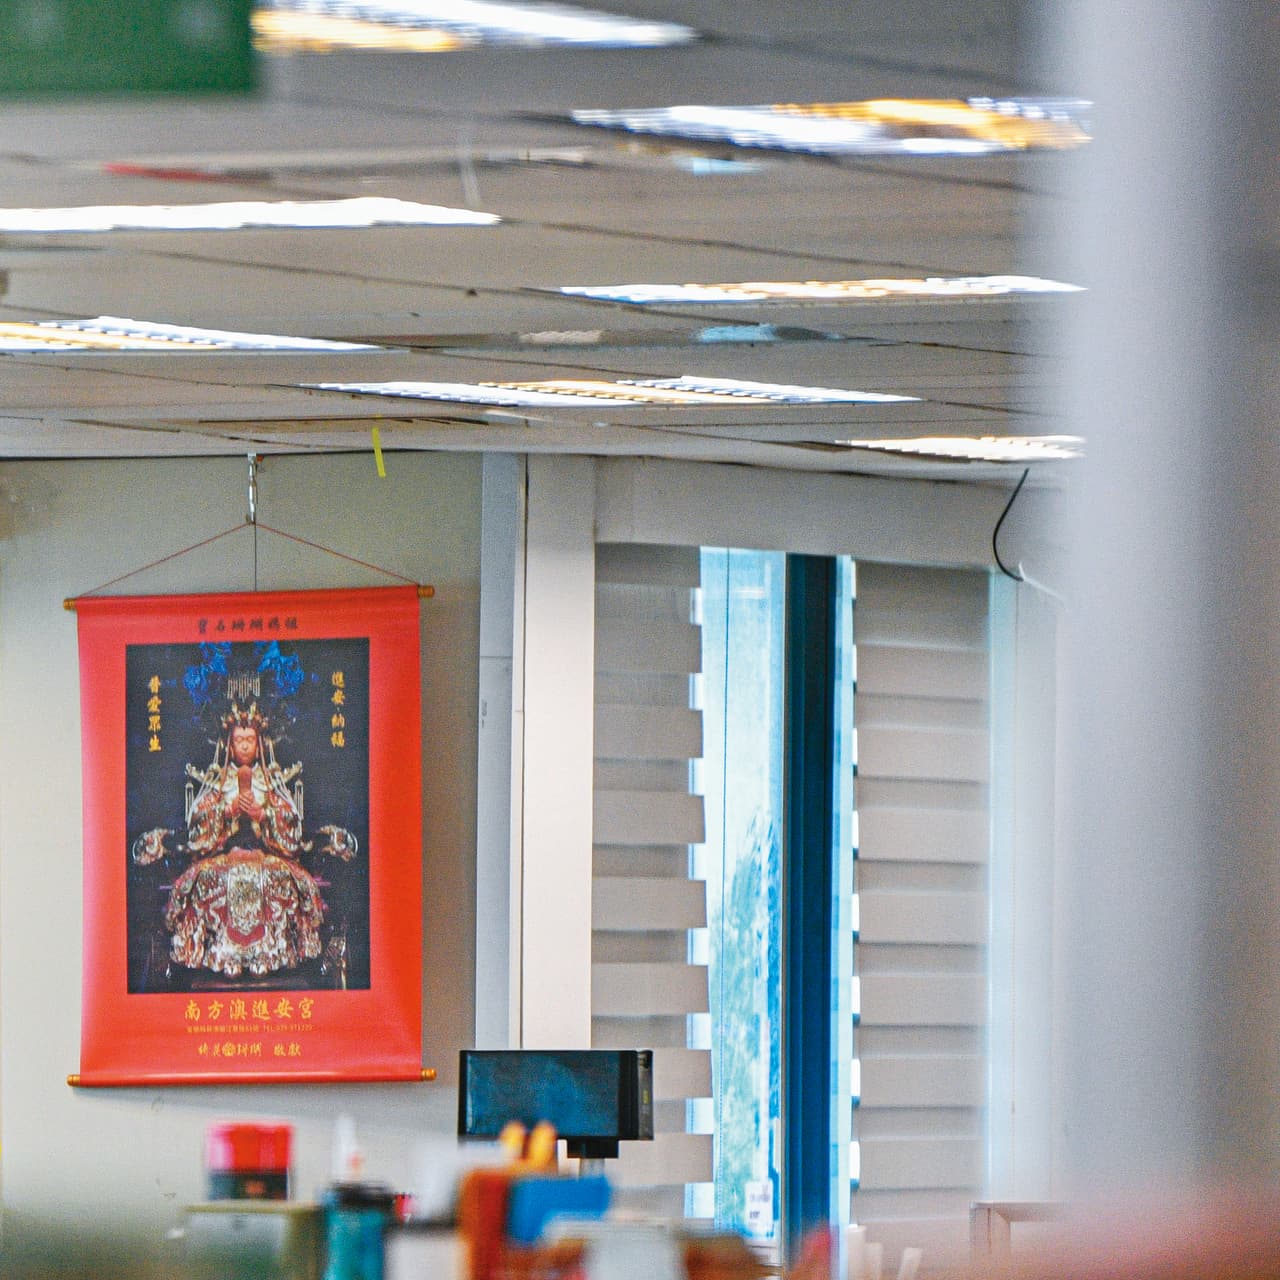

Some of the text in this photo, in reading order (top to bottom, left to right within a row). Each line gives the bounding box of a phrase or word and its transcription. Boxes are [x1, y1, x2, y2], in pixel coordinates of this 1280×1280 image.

[184, 997, 314, 1020] 南方澳進安宮
